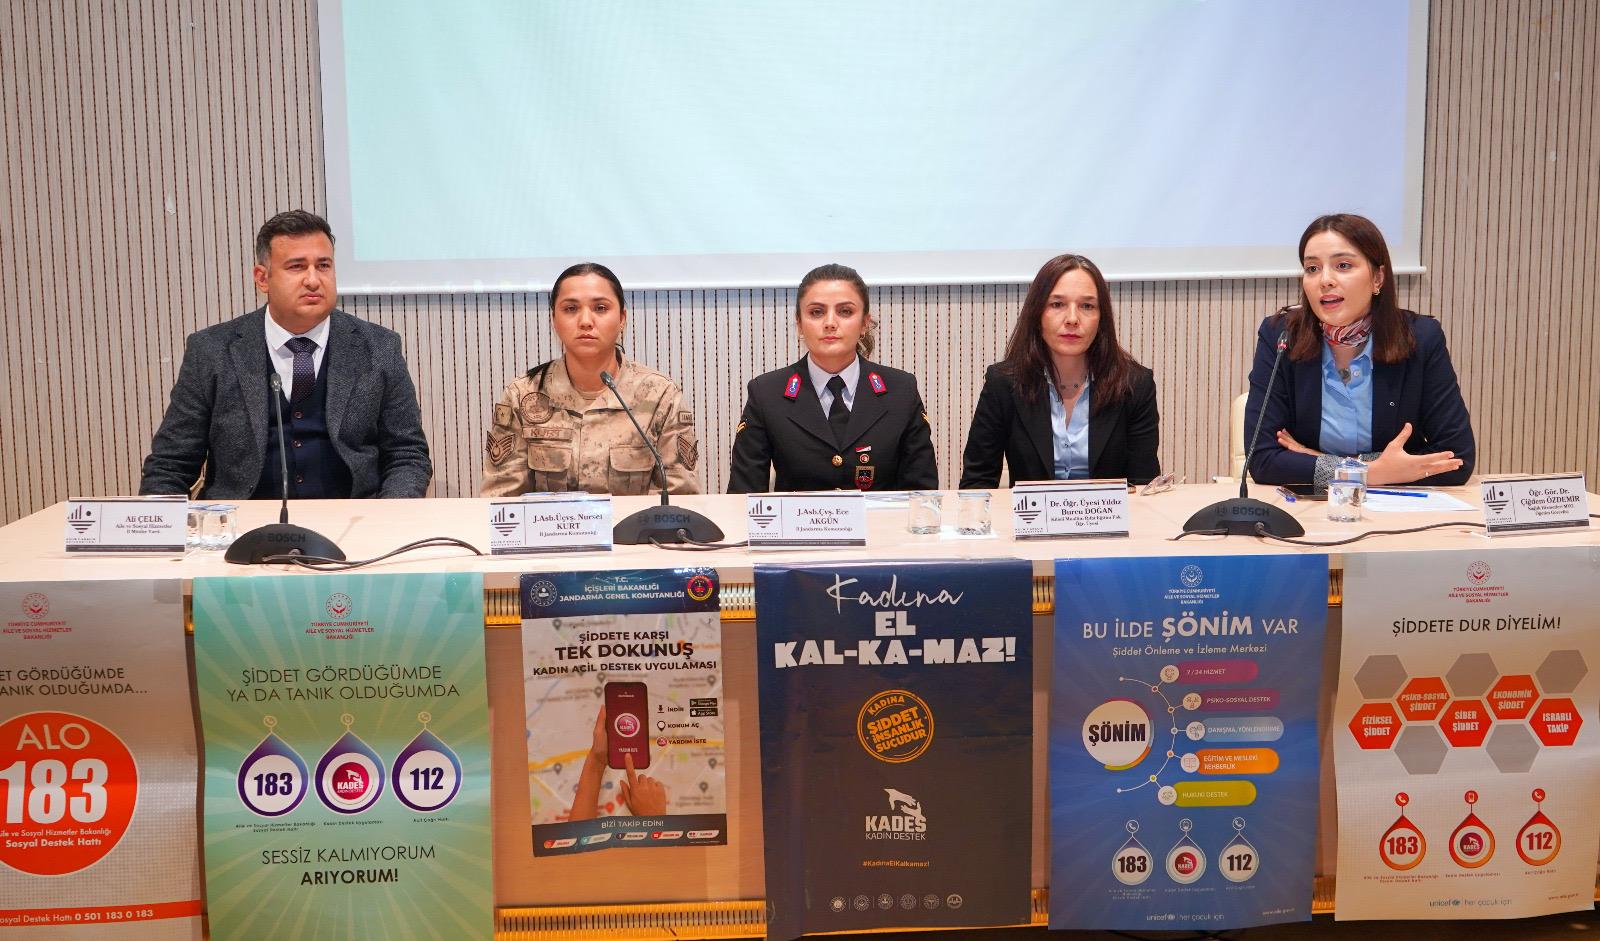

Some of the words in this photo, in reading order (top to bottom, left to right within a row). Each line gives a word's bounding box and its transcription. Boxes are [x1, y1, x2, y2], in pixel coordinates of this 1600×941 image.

[1063, 499, 1078, 507] Öğr.
[1080, 499, 1099, 507] Üyesi
[1085, 506, 1112, 514] DOĞAN
[655, 514, 690, 523] BOSCH
[1233, 507, 1270, 516] BOSCH
[137, 515, 163, 523] ÇELİK
[267, 533, 306, 542] BOSCH
[585, 584, 616, 593] İÇİŞLERİ
[617, 583, 659, 591] BAKANLIĞI
[826, 573, 963, 614] Kadına
[560, 593, 604, 602] JANDARMA
[632, 590, 685, 599] KOMUTANLIĞI
[875, 610, 916, 636] EL
[1083, 623, 1107, 638] BU
[1115, 618, 1153, 638] İLDE
[1161, 610, 1253, 643] ŞÖNİM
[1262, 619, 1298, 635] VAR
[1392, 617, 1453, 637] ŞİDDETE
[1459, 618, 1490, 632] DUR
[1496, 613, 1561, 631] DİYELİM!
[579, 631, 629, 644] ŞİDDETE
[633, 631, 669, 641] KARŞI
[555, 646, 592, 660] TEK
[598, 642, 694, 659] DOKUNUŞ
[774, 637, 1016, 668] KAL-KA-MAZ!
[1112, 646, 1142, 658] Şiddet
[1145, 644, 1181, 655] Önleme
[1197, 643, 1227, 654] İzleme
[1230, 644, 1267, 653] Merkezi
[0, 671, 12, 680] ET
[17, 666, 124, 680] GÖRDÜĞÜMDE
[533, 666, 569, 675] KADIN
[572, 664, 597, 673] ACİL
[600, 662, 642, 671] DESTEK
[644, 661, 717, 670] UYGULAMASI
[242, 668, 300, 686] ŞİDDET
[306, 665, 441, 682] GÖRDÜĞÜMDE
[0, 685, 34, 696] ANIK
[39, 682, 148, 695] OLDUĞUMDA...
[226, 688, 248, 702] YA
[254, 688, 281, 701] DA
[285, 687, 334, 700] TANIK
[339, 683, 460, 699] OLDUĞUMDA
[1493, 689, 1532, 698] EKONOMİK
[867, 695, 905, 715] KADINA
[1409, 702, 1436, 712] ŞİDDET
[1498, 700, 1524, 710] ŞİDDET
[867, 706, 919, 738] ŞİDDET
[1362, 716, 1392, 725] FİZİKSEL
[1455, 710, 1477, 720] SİBER
[872, 719, 924, 744] İNSANLIK
[1088, 720, 1146, 746] ŞÖNİM
[1364, 727, 1390, 736] ŞİDDET
[1452, 722, 1479, 732] ŞİDDET
[1547, 724, 1569, 733] TAKİP
[16, 723, 91, 750] ALO
[876, 729, 926, 753] SUÇUDUR
[254, 773, 293, 796] 183
[337, 781, 364, 789] KADES
[409, 767, 444, 790] 112
[0, 758, 108, 824] 183
[601, 820, 616, 829] BİZİ
[865, 815, 926, 832] KADES
[6, 839, 38, 849] Sosyal
[41, 838, 74, 846] Destek
[866, 832, 891, 840] KADIN
[893, 832, 926, 841] DESTEK
[1526, 832, 1553, 851] 112
[1387, 836, 1418, 855] 183
[262, 847, 311, 865] SESSİZ
[318, 846, 435, 863] KALMIYORUM
[1227, 853, 1252, 871] 112
[1117, 855, 1147, 873] 183
[301, 869, 399, 885] ARIYORUM!
[0, 916, 21, 924] osyal
